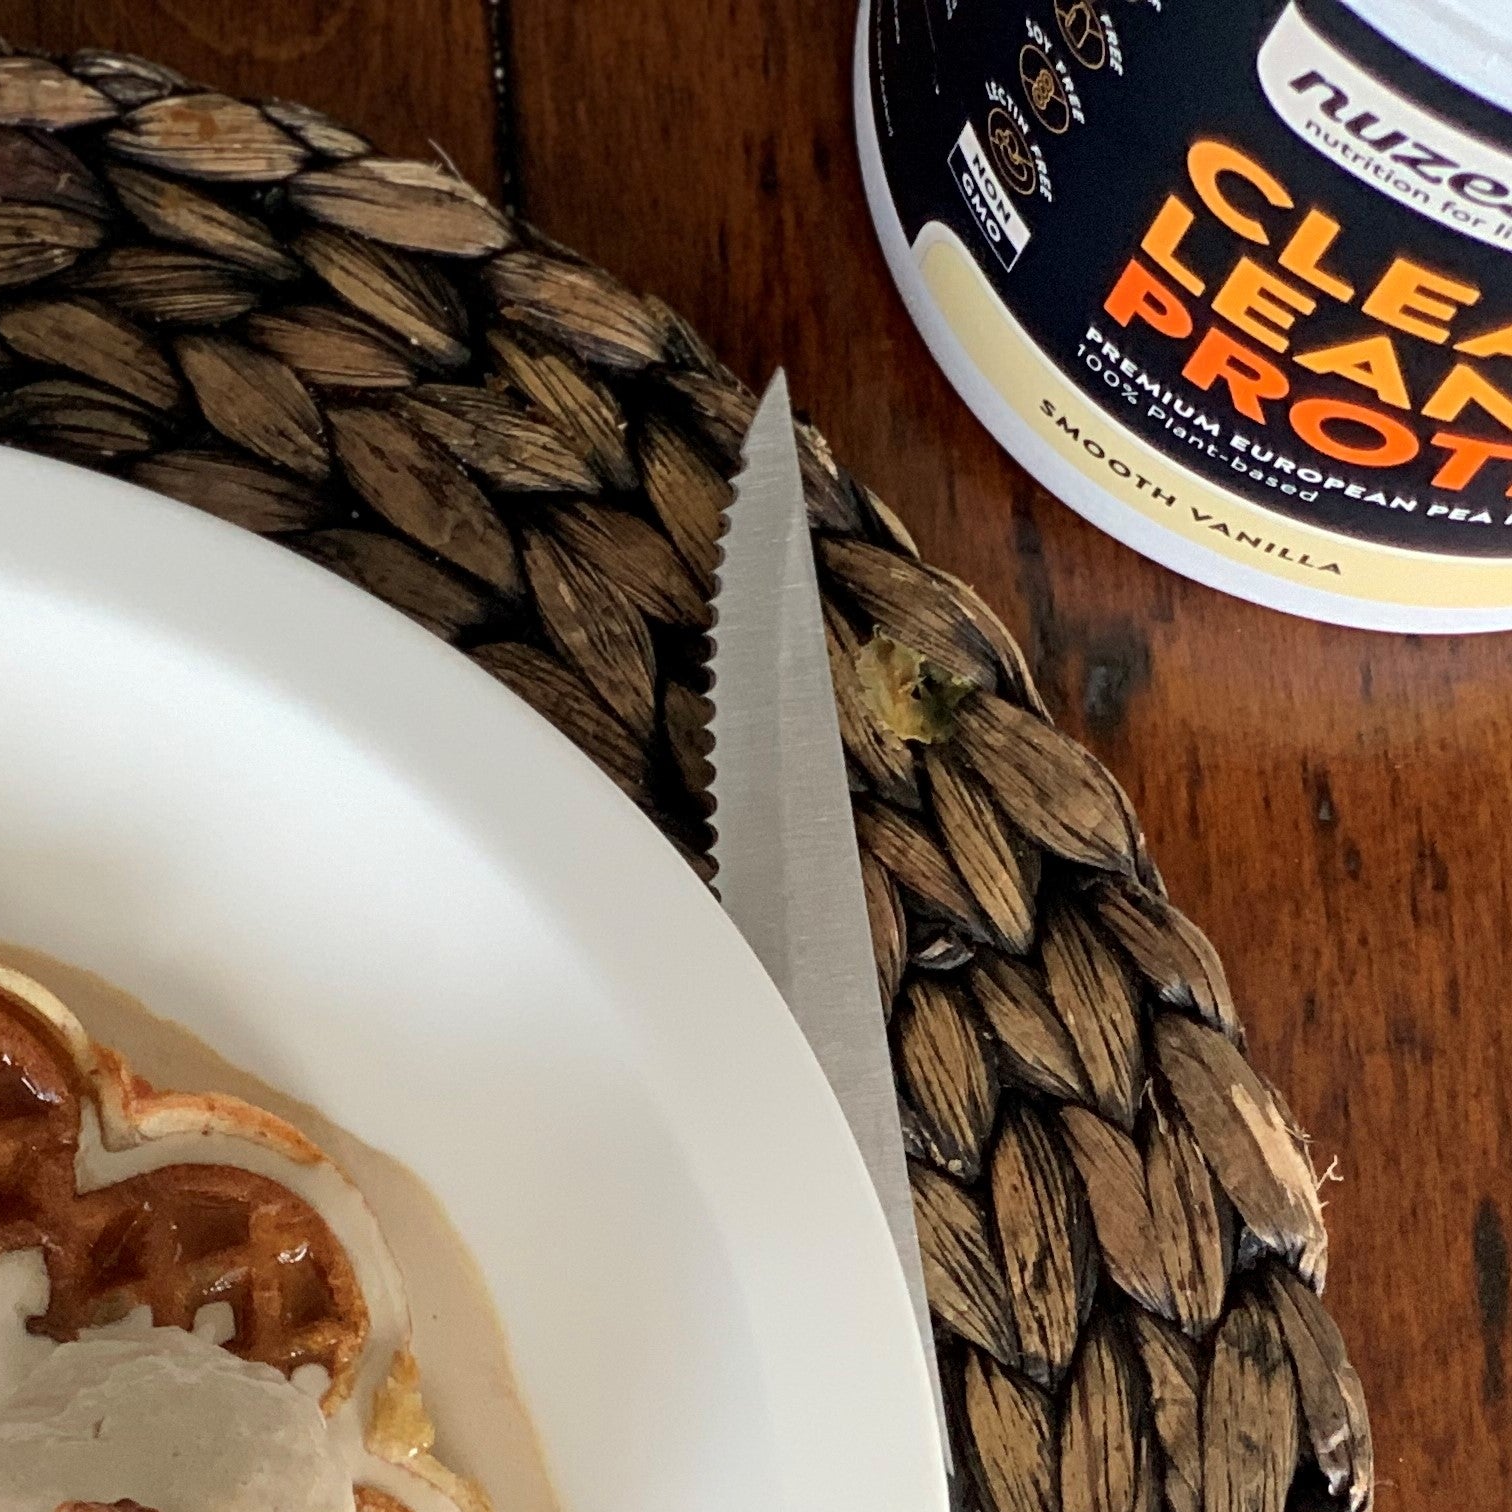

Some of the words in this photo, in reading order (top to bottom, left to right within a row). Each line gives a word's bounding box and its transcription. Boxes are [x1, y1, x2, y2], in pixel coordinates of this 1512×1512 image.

[1025, 16, 1053, 54] SOY
[1055, 59, 1085, 125] FREE
[962, 171, 1001, 242] GMO
[972, 153, 1011, 224] NON
[985, 79, 1029, 135] LECTIN
[1030, 143, 1053, 203] FREE
[1288, 69, 1512, 219] nuze
[1304, 119, 1430, 205] nutrition
[1440, 201, 1487, 227] for
[1077, 343, 1139, 405] 100%
[1147, 404, 1320, 504] Plant-based
[1085, 326, 1220, 437] PREMIUM
[1229, 434, 1418, 513] EUROPEAN
[1426, 503, 1493, 524] PEA
[1103, 256, 1512, 497] PROT
[1039, 398, 1177, 507] SMOOTH
[1189, 506, 1343, 576] VANILLA
